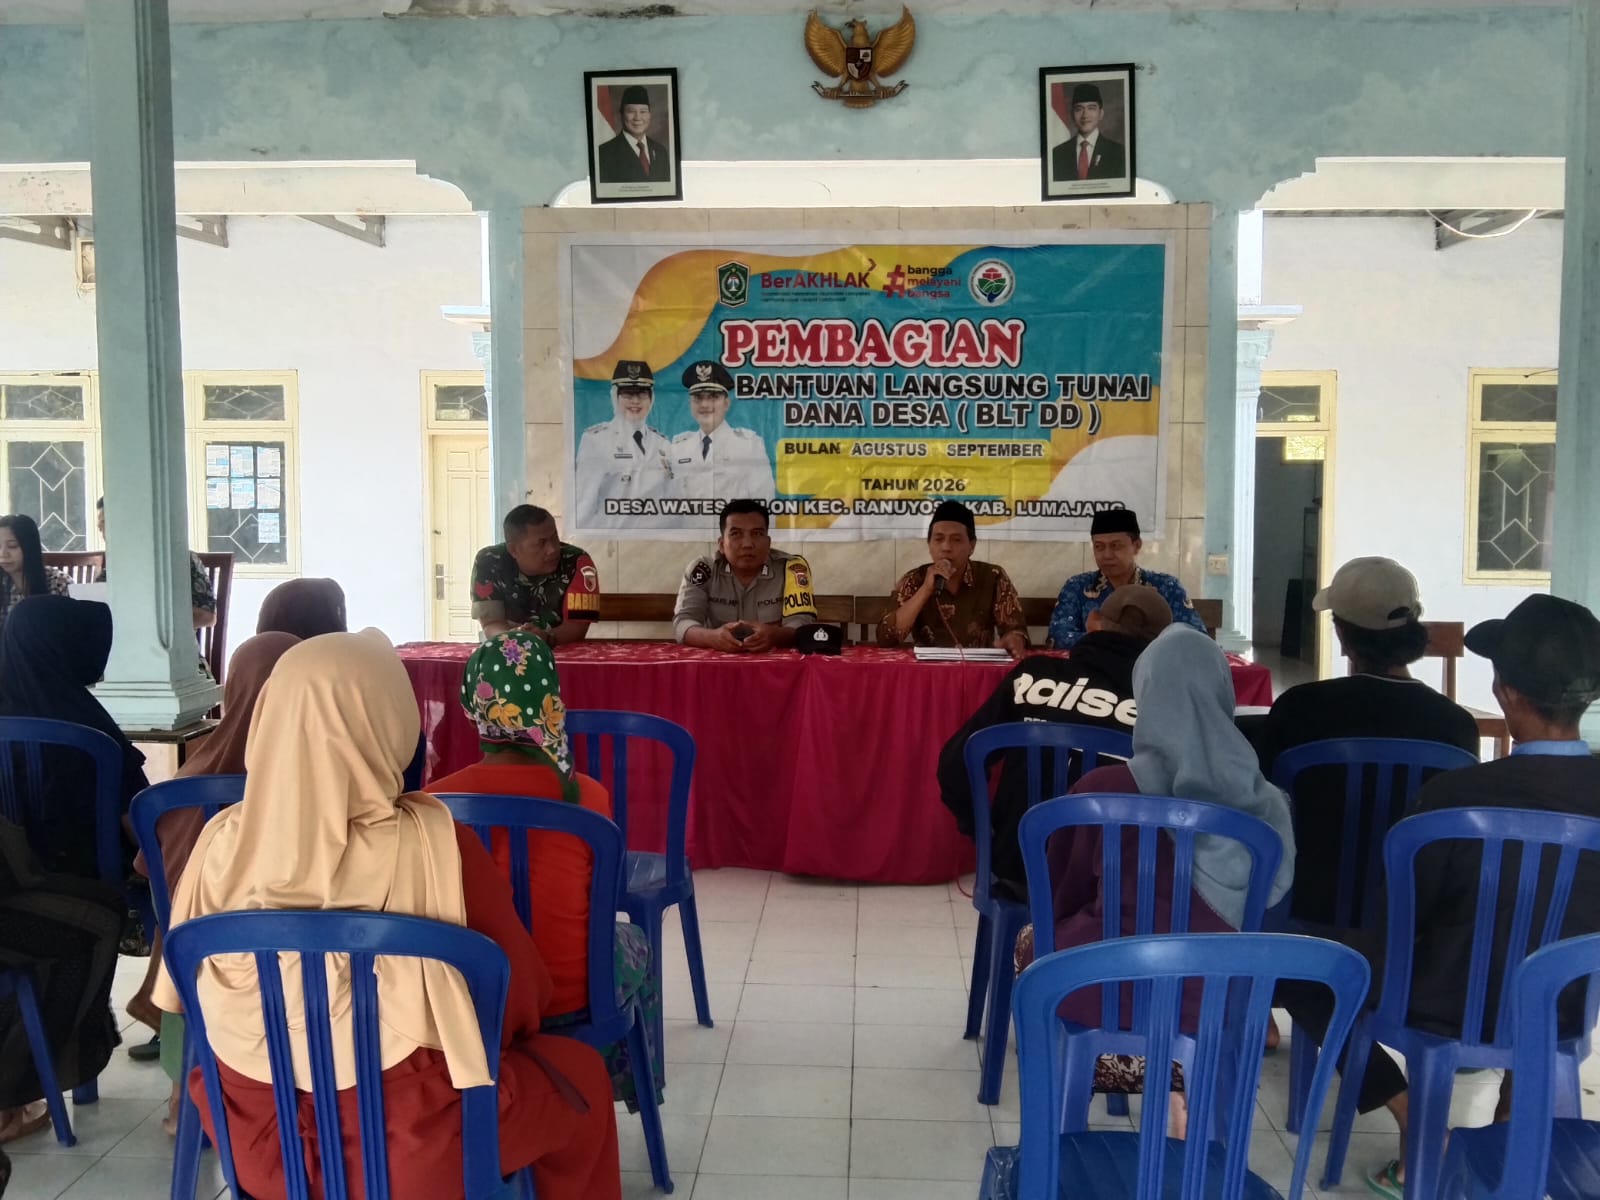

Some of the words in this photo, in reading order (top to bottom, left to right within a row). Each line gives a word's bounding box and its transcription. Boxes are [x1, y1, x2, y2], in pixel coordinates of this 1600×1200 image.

[907, 265, 953, 276] bangga
[761, 272, 870, 288] BerAKHLAK
[907, 277, 962, 288] melayani
[721, 320, 1024, 367] PEMBAGIAN
[736, 374, 876, 398] BANTUAN
[884, 374, 1048, 399] LANGSUNG
[1055, 374, 1150, 399] TUNAI
[784, 401, 865, 426] DANA
[872, 401, 950, 426] DESA
[784, 442, 841, 455] BULAN
[851, 442, 928, 457] AGUSTUS
[946, 443, 1044, 457] SEPTEMBER
[861, 478, 919, 491] TAHUN
[922, 478, 966, 492] 2026
[606, 500, 656, 514] DESA
[660, 500, 725, 514] WATES
[803, 499, 849, 514] KEC.
[854, 500, 943, 515] RANUYO
[965, 500, 1011, 515] KAB.
